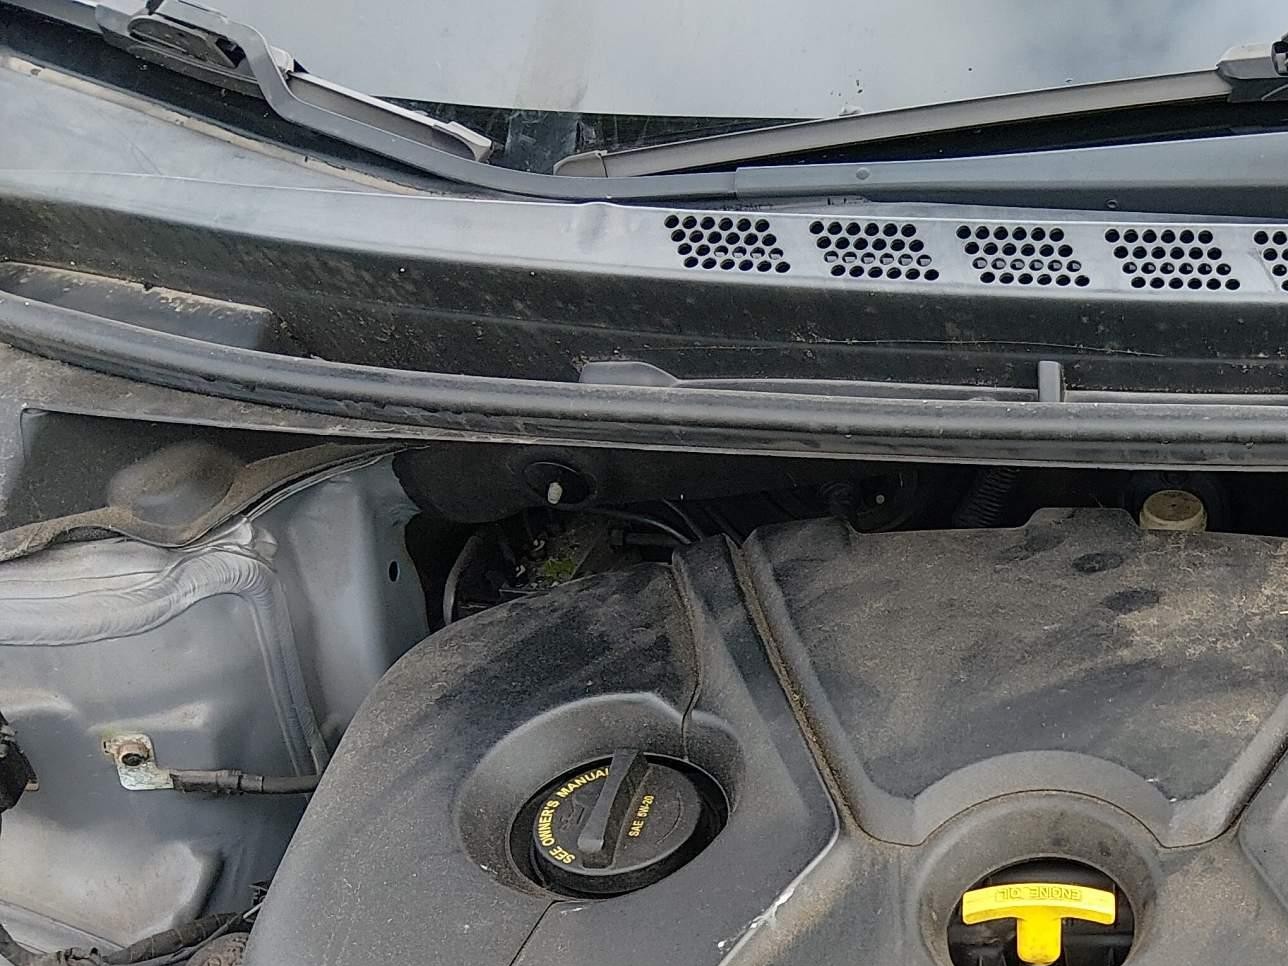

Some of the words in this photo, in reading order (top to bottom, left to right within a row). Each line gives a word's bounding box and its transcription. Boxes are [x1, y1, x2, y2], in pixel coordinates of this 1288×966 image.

[538, 800, 560, 847] OWNER'S
[628, 820, 644, 838] SAE
[636, 795, 655, 818] 5W-20
[549, 845, 575, 864] SEE
[1029, 886, 1082, 901] ENGINE
